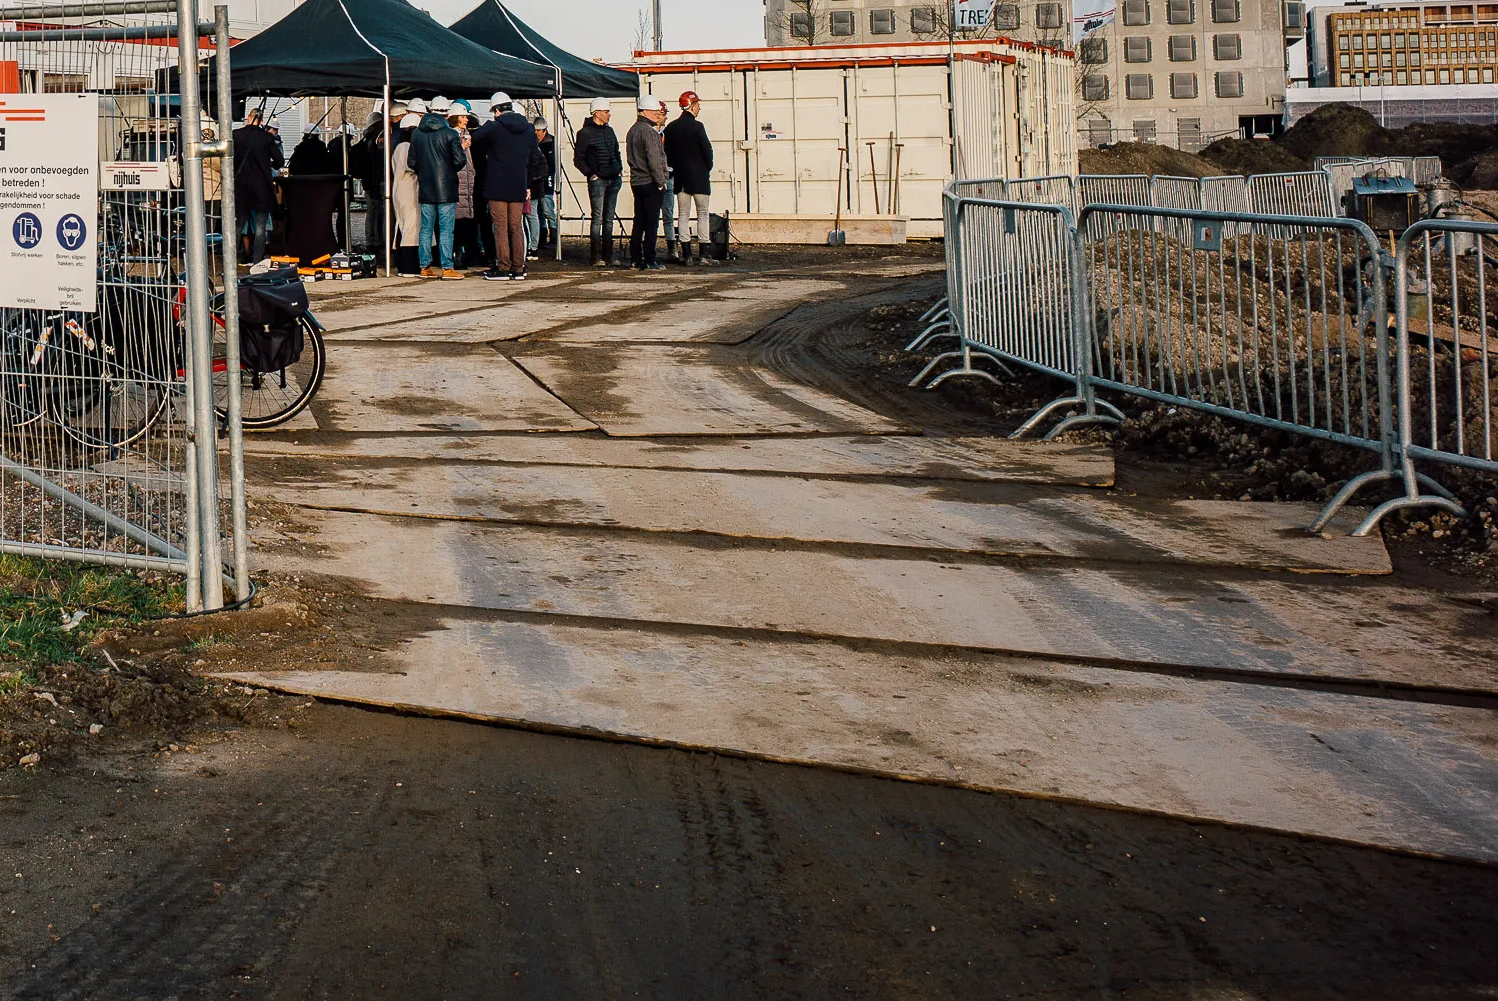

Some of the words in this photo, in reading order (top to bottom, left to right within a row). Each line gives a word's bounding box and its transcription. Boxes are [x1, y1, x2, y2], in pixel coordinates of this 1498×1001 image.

[30, 165, 89, 177] onbevoegden
[2, 178, 40, 188] betreden
[42, 179, 45, 187] !
[114, 171, 140, 187] nijhuis
[55, 192, 80, 200] schade
